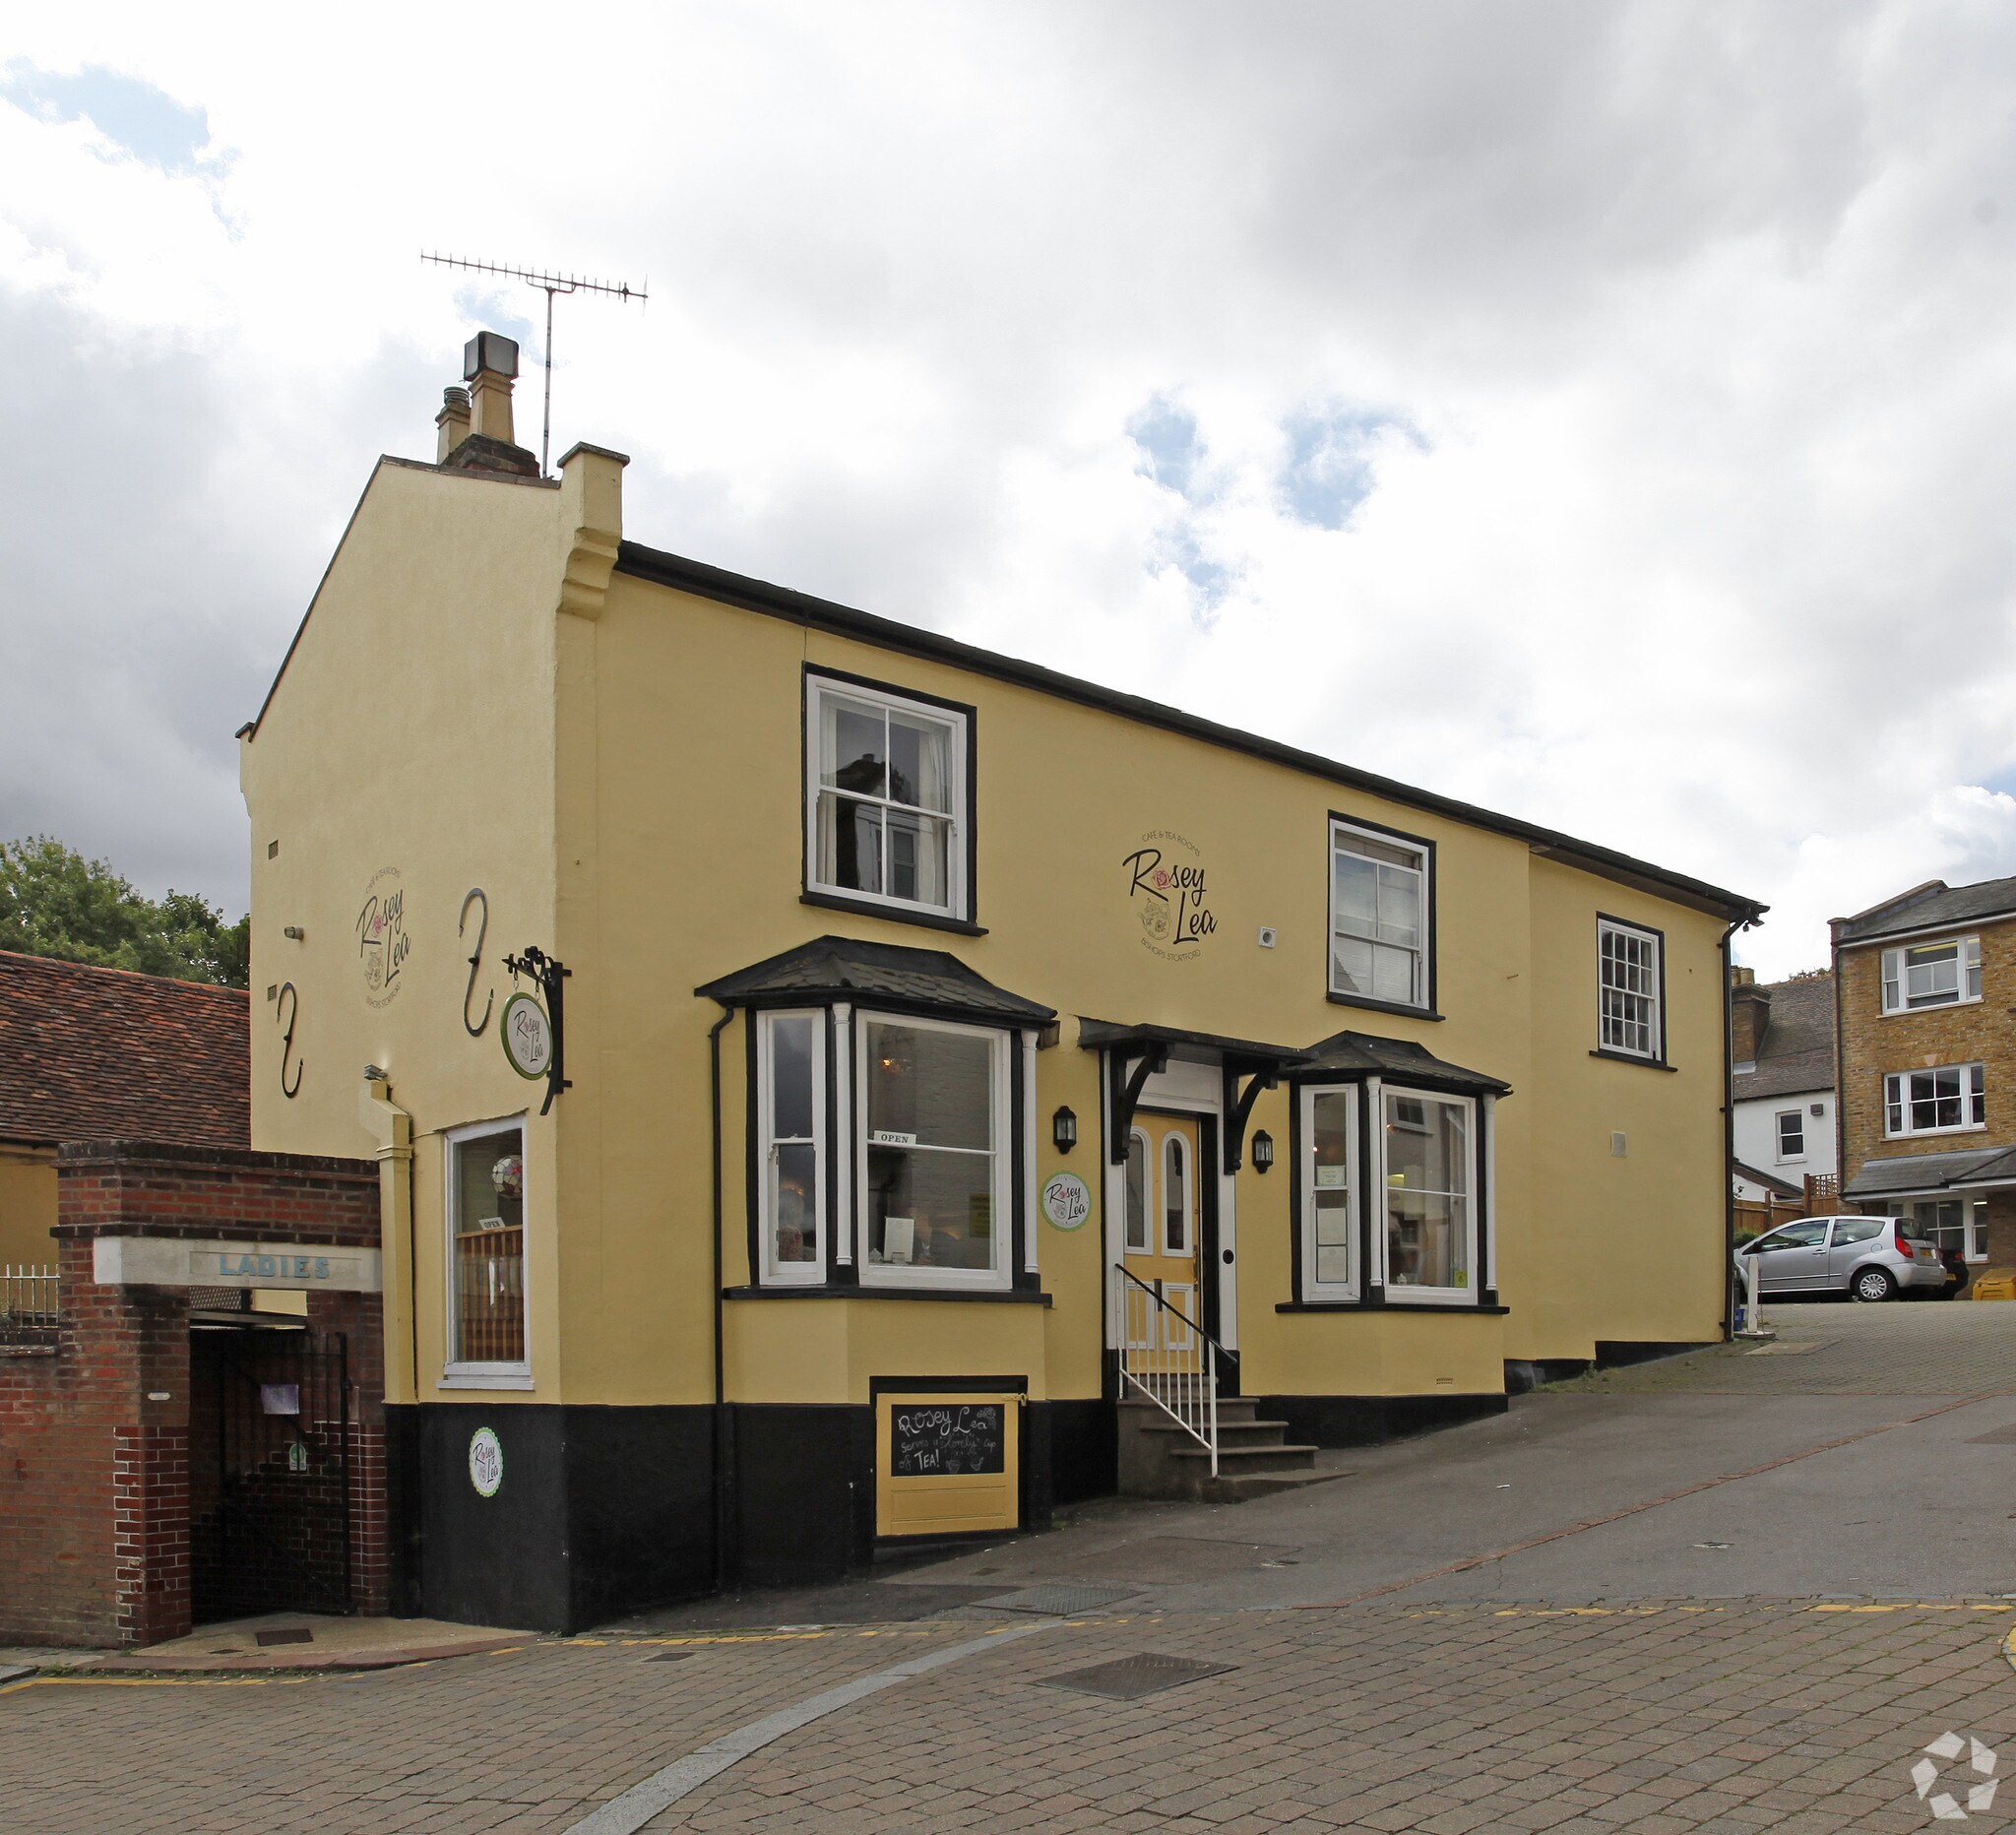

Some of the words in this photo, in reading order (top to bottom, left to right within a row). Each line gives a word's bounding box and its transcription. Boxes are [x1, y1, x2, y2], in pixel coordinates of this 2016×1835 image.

[1165, 831, 1176, 841] TEA
[1172, 891, 1219, 945] Lea
[384, 924, 411, 987] Lea
[530, 1034, 543, 1062] Lea
[881, 1133, 909, 1144] OPEN
[1068, 1197, 1087, 1220] Lea
[220, 1253, 331, 1279] LADIES
[898, 1410, 952, 1437] Rosey
[953, 1406, 987, 1433] Lea
[486, 1458, 499, 1484] Lea
[899, 1455, 912, 1471] of
[914, 1449, 940, 1471] TEA!
